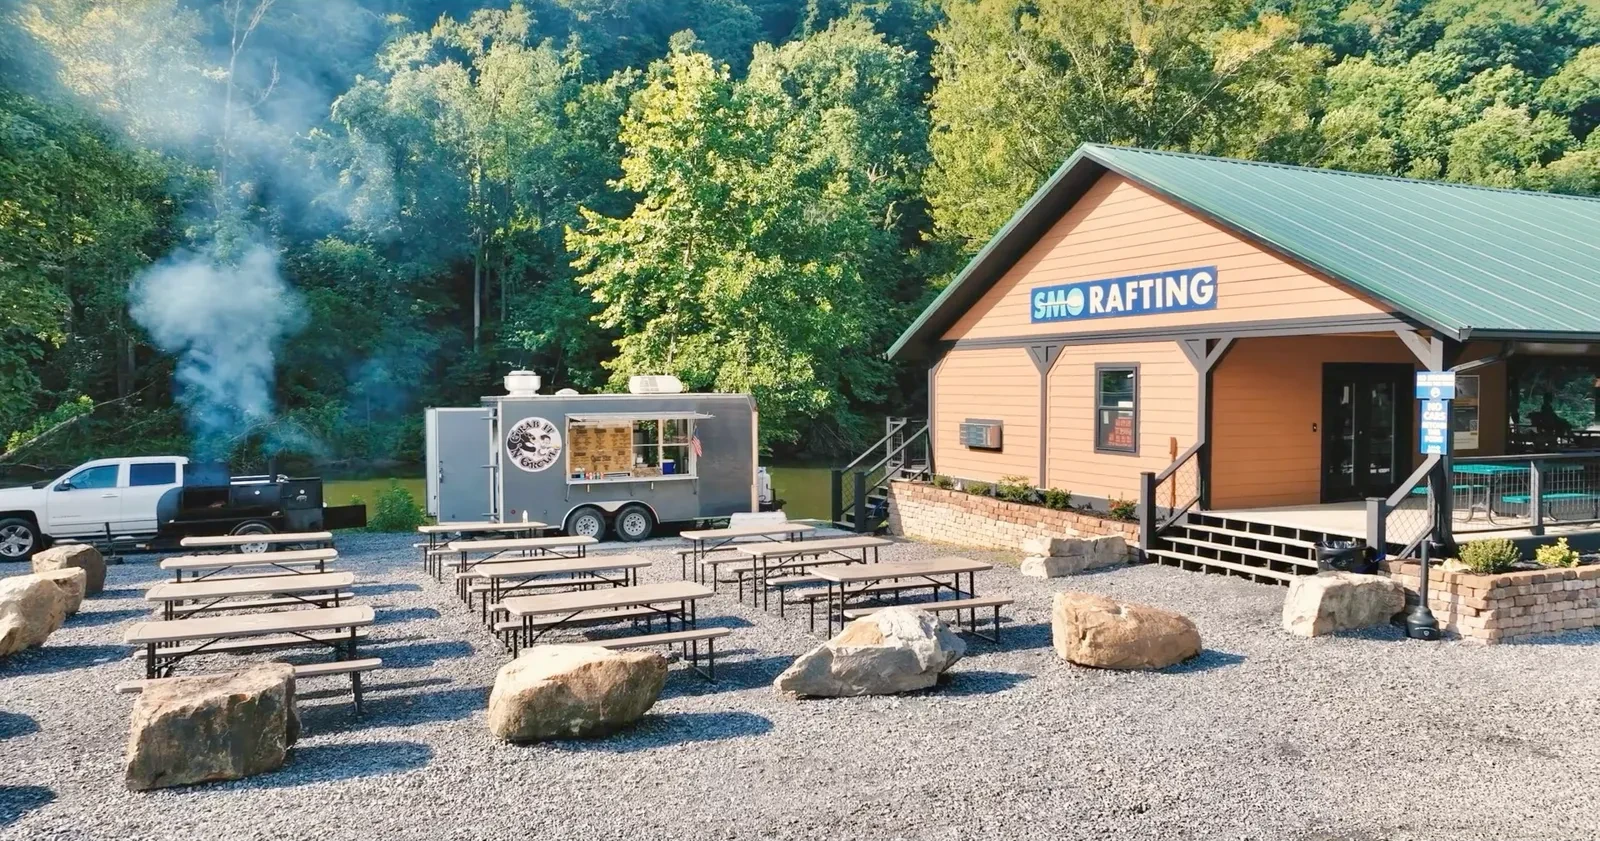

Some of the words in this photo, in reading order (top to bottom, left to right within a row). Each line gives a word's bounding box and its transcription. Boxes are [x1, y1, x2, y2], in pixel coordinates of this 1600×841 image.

[1034, 287, 1085, 319] SMO
[1089, 271, 1214, 314] RAFTING
[1427, 402, 1443, 411] NO
[1423, 411, 1446, 421] CARS
[510, 420, 541, 442] GRAB
[543, 424, 554, 434] IT
